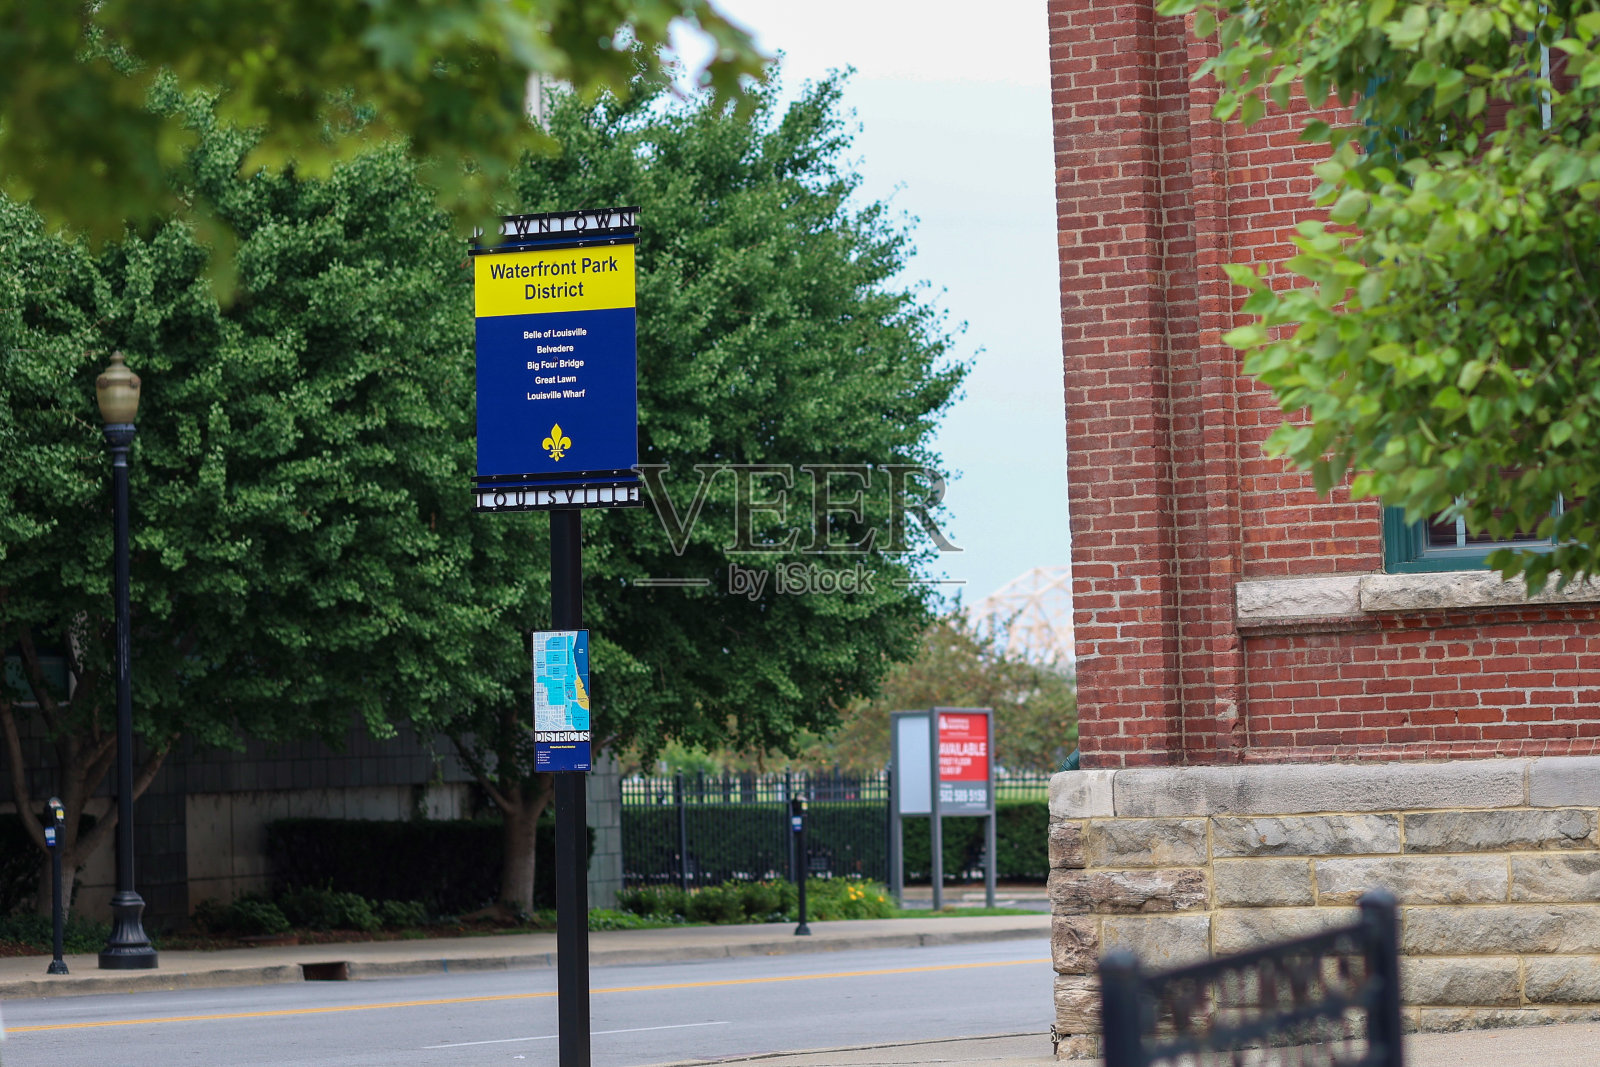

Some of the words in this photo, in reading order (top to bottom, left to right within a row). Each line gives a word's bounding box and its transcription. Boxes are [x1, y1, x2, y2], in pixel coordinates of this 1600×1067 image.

[490, 260, 577, 280] Waterfront
[581, 256, 618, 274] Park
[525, 281, 584, 300] District
[523, 330, 542, 339] Belle
[543, 329, 552, 338] of
[552, 327, 587, 338] Louisville
[536, 344, 574, 354] Belvedere
[527, 361, 540, 371] Big
[541, 360, 558, 369] Four
[559, 358, 585, 369] Bridge
[535, 375, 556, 385] Great
[557, 375, 577, 384] Lawn
[527, 390, 562, 401] Louisville
[562, 388, 586, 399] Wharf
[477, 486, 639, 508] LOUISVILLE
[535, 731, 590, 743] DISTRICTS
[939, 742, 987, 757] AVAILABLE
